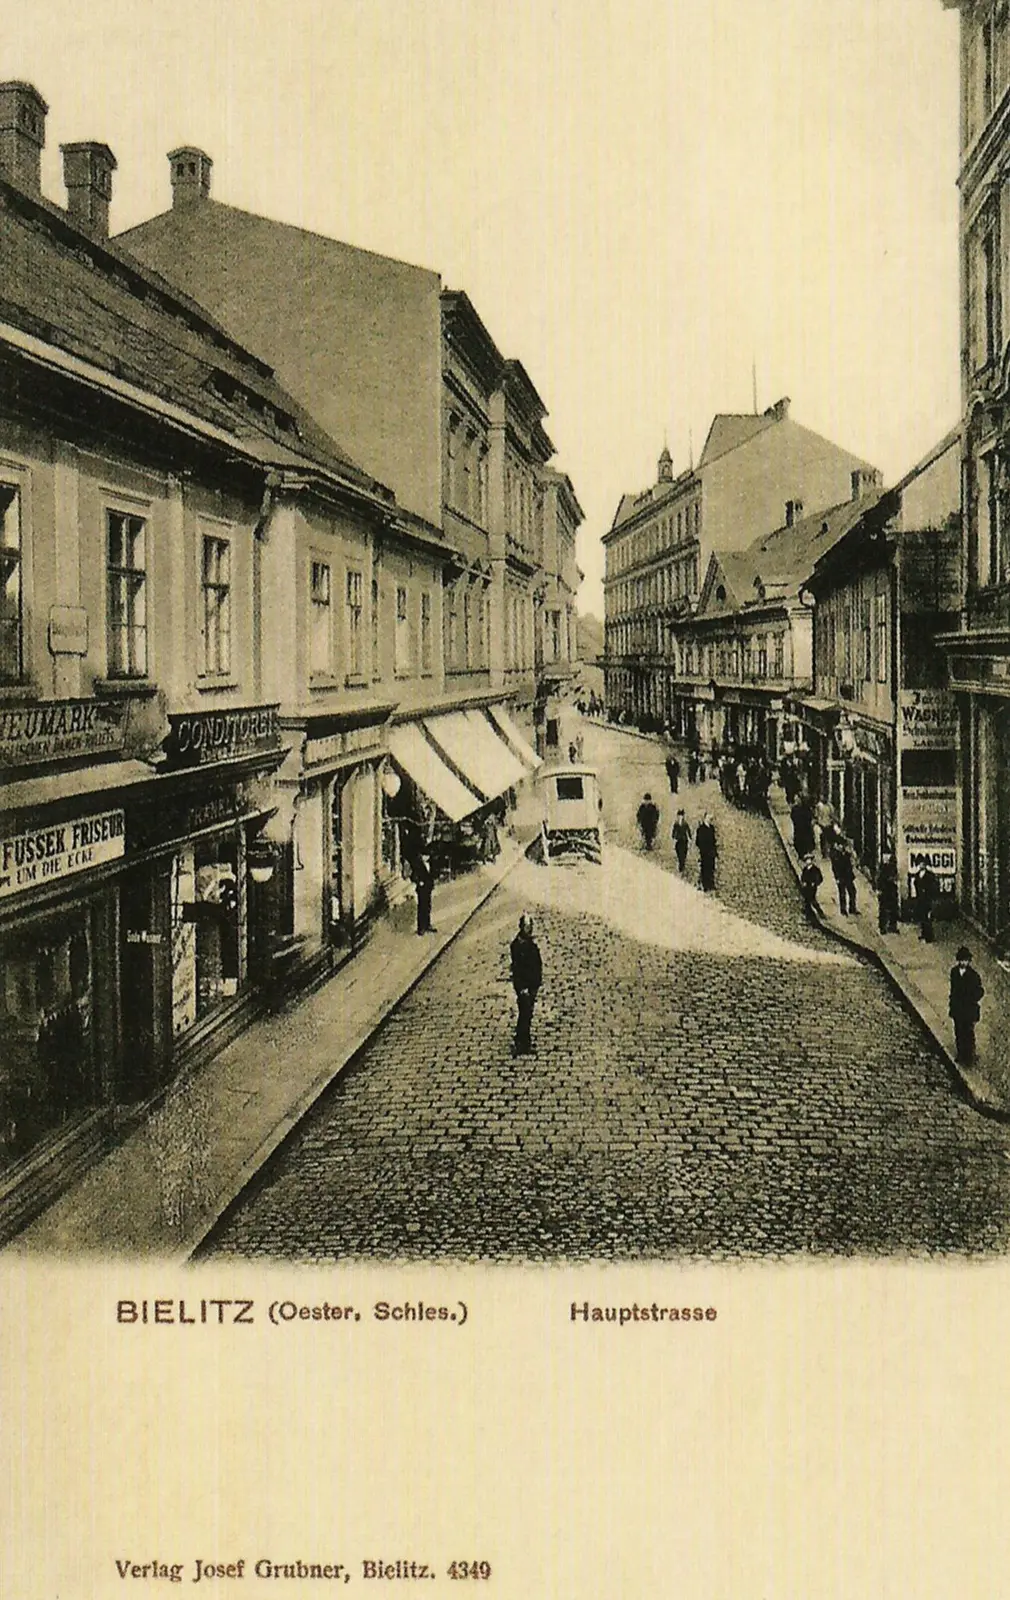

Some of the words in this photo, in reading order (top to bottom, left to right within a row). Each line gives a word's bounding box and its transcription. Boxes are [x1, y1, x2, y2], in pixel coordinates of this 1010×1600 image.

[3, 828, 66, 870] FUSSEK
[72, 812, 124, 850] FRISEUR
[16, 864, 36, 885] UM
[42, 856, 62, 876] DIE
[910, 853, 954, 868] MAGGI
